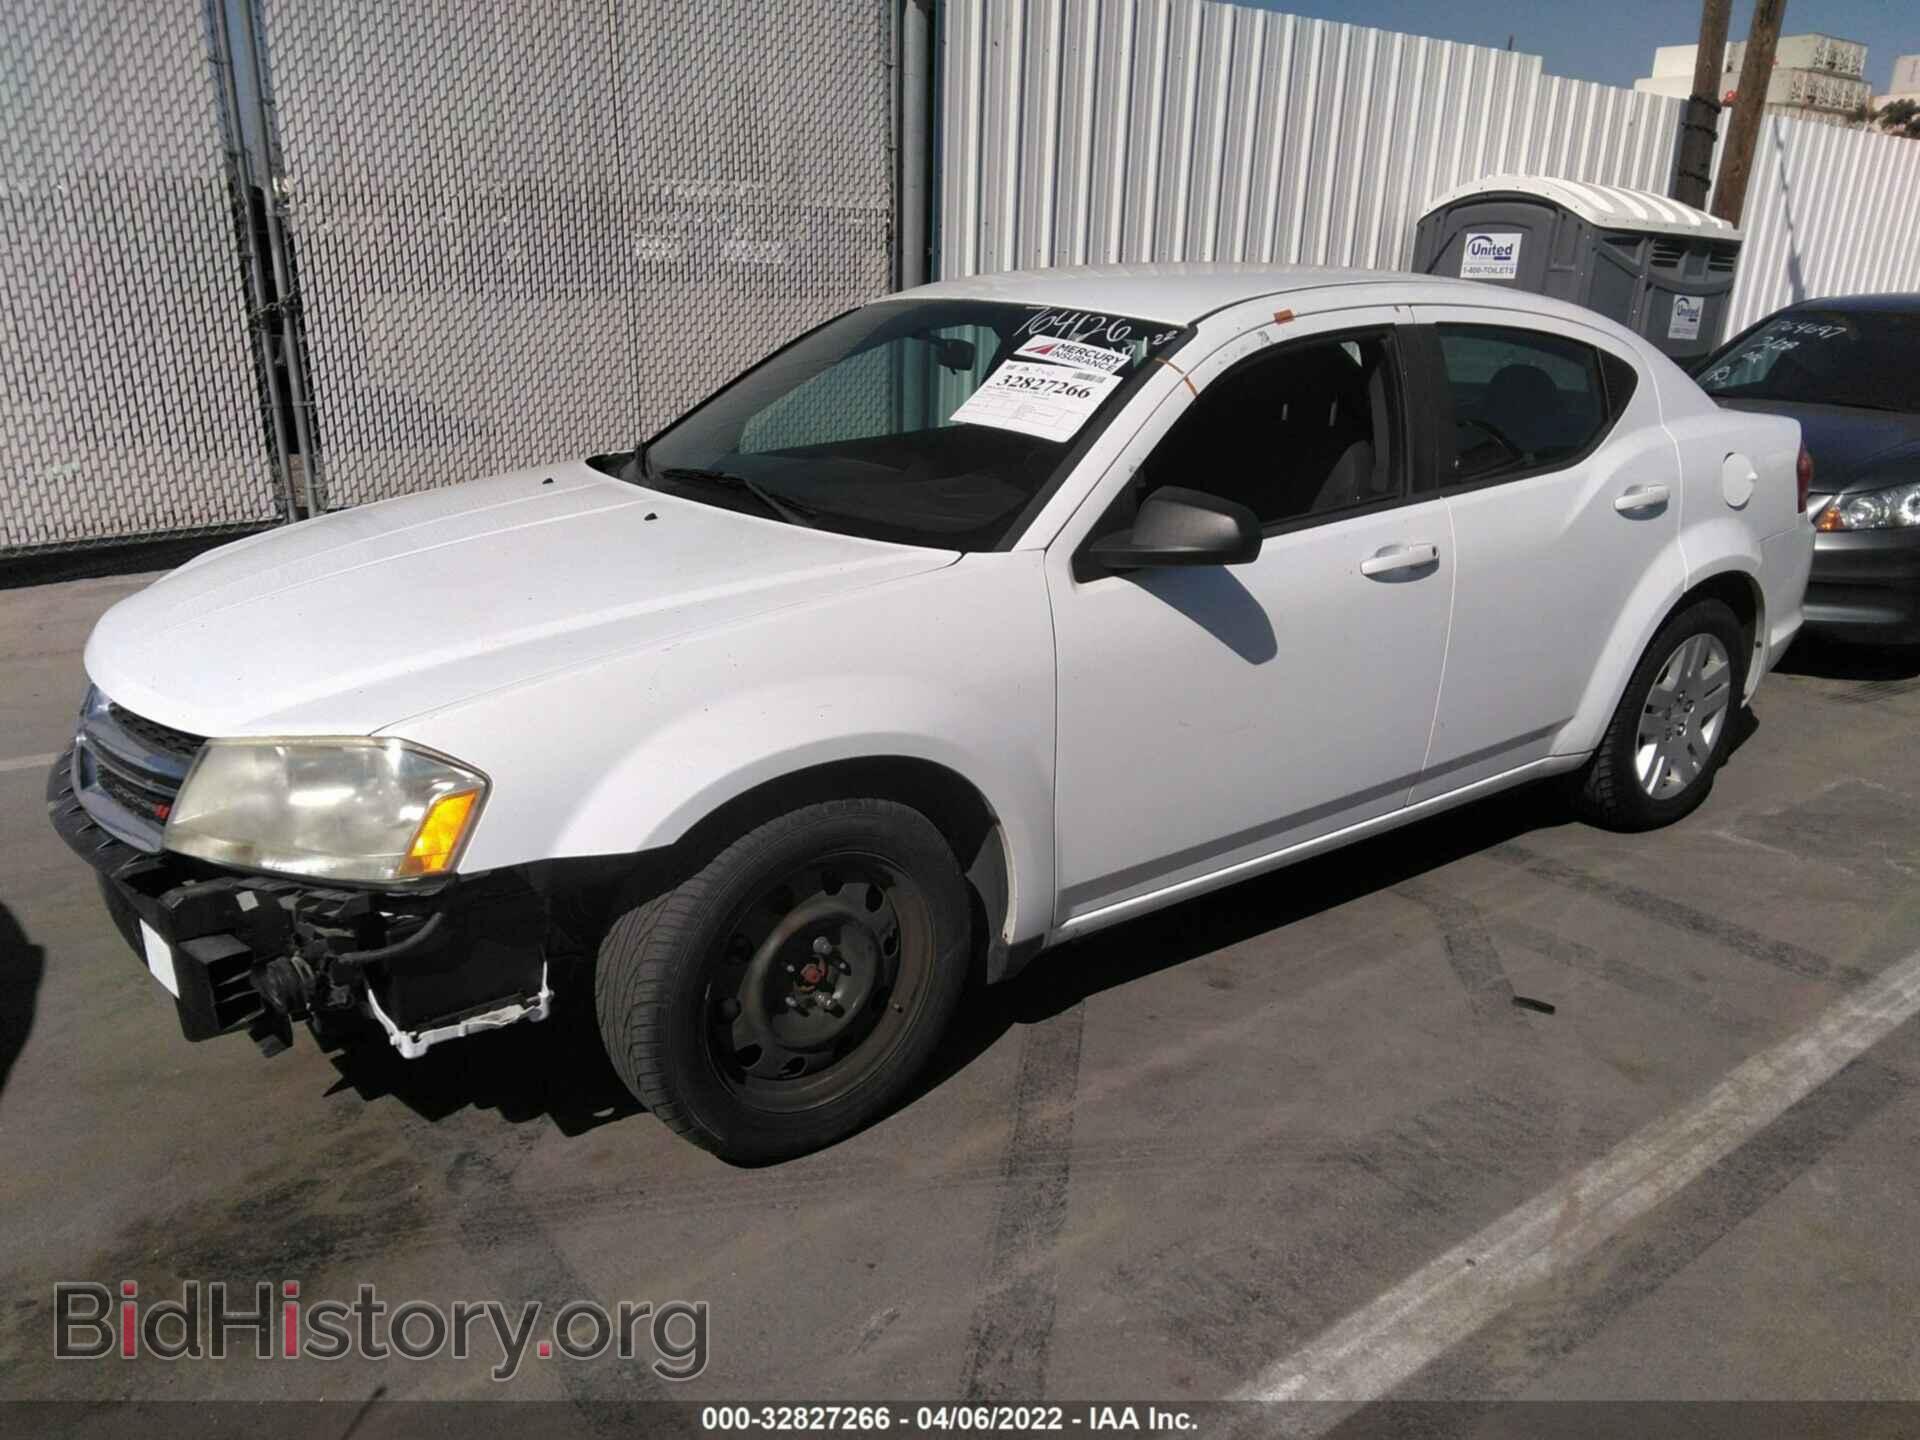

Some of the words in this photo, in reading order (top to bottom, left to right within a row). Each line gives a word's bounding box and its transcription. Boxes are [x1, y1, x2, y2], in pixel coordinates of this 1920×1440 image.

[1471, 243, 1513, 256] United
[1050, 350, 1118, 373] INSURANCE
[1055, 343, 1125, 365] MERCURY
[996, 374, 1094, 399] 32827266
